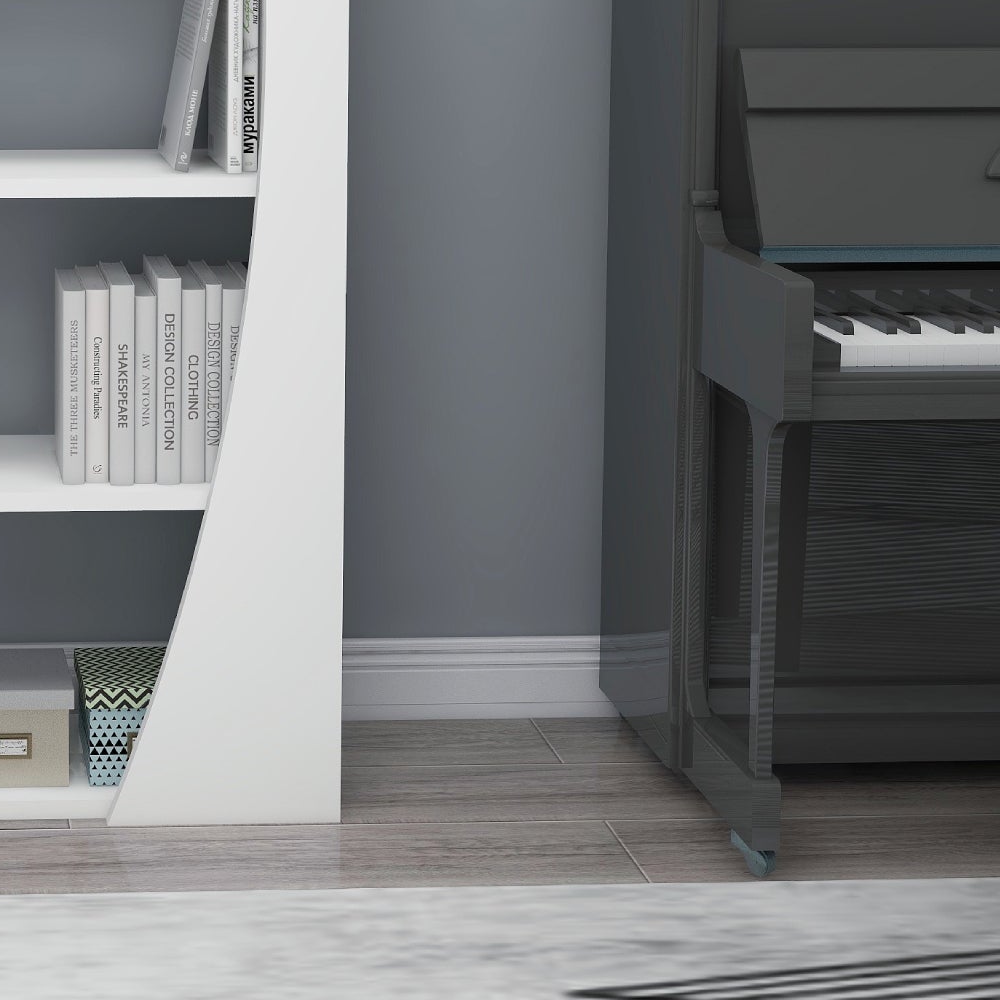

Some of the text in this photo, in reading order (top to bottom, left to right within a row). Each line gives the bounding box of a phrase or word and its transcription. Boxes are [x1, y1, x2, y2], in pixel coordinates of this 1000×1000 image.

[243, 76, 258, 153] мураками
[70, 320, 79, 456] THE THREE MUSKETEERS
[91, 336, 103, 386] Constructing
[118, 343, 129, 429] SHAKESPEARE
[142, 353, 151, 427] MY ANTONIA
[164, 314, 175, 451] DESIGN COLLECTION
[188, 355, 199, 420] CLOTHING
[206, 322, 221, 447] DESIGN COLLECTION
